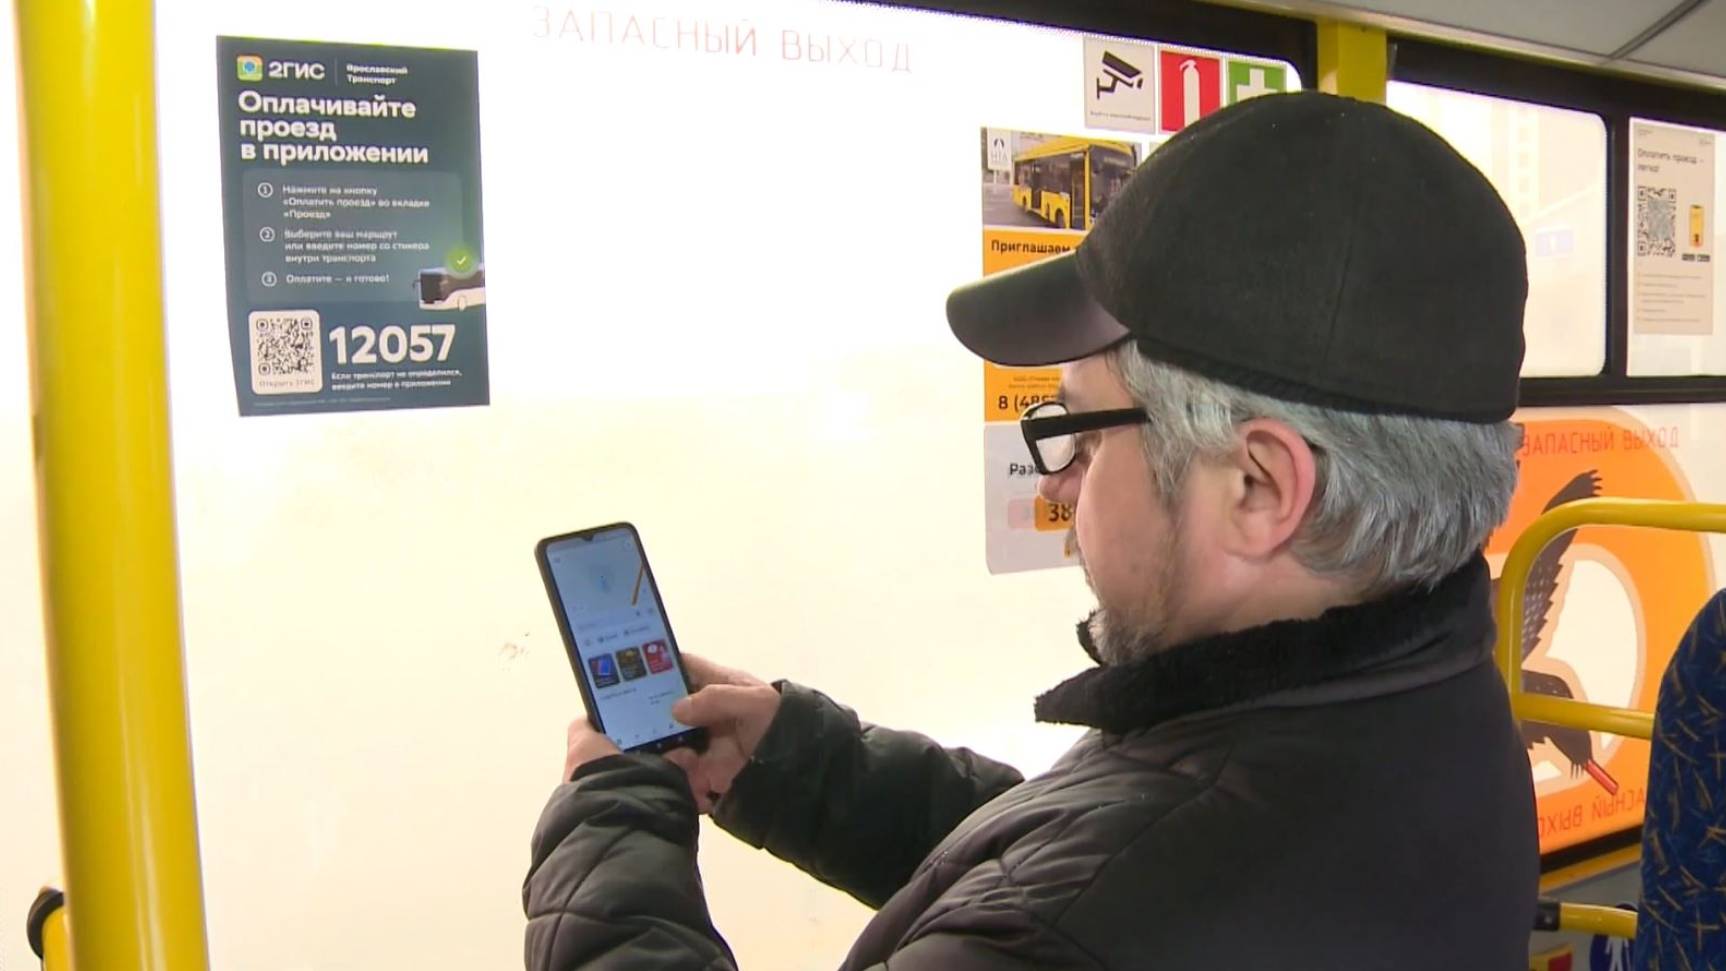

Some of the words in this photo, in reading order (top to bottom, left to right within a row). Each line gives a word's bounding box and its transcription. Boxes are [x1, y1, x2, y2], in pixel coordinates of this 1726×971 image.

[532, 5, 757, 56] ЗАПАСНЫЙ
[781, 29, 912, 74] ВЫХОД
[268, 61, 325, 80] 2ГИС
[346, 63, 408, 75] Ярославский
[346, 74, 397, 85] Транспорт
[238, 90, 417, 118] Оплачивайте
[239, 119, 337, 142] проезд
[240, 143, 256, 160] в
[263, 143, 429, 166] приложении
[283, 185, 327, 196] Нажмите
[329, 187, 341, 195] на
[343, 187, 377, 197] кнопку
[283, 197, 334, 207] «Оплатить
[336, 199, 376, 209] проезд»
[378, 200, 390, 208] во
[283, 209, 331, 219] «Проезд»
[284, 229, 332, 240] Выберите
[335, 231, 354, 239] ваш
[356, 231, 397, 240] маршрут
[285, 242, 303, 251] или
[306, 242, 344, 252] введите
[346, 243, 377, 251] номер
[379, 243, 390, 251] со
[392, 242, 430, 251] стикера
[991, 239, 1071, 257] Приглашаем
[285, 254, 319, 264] внутри
[322, 254, 376, 264] транспорта
[286, 274, 332, 284] Оплатите
[354, 274, 390, 283] готово!
[329, 324, 456, 364] 12057
[331, 371, 352, 380] Если
[352, 371, 395, 381] транспорт
[331, 382, 365, 391] введите
[366, 381, 393, 391] номер
[998, 395, 1008, 409] 8
[1522, 427, 1614, 457] ЗАПАСНЫЙ
[1623, 426, 1680, 450] ВЫХОД
